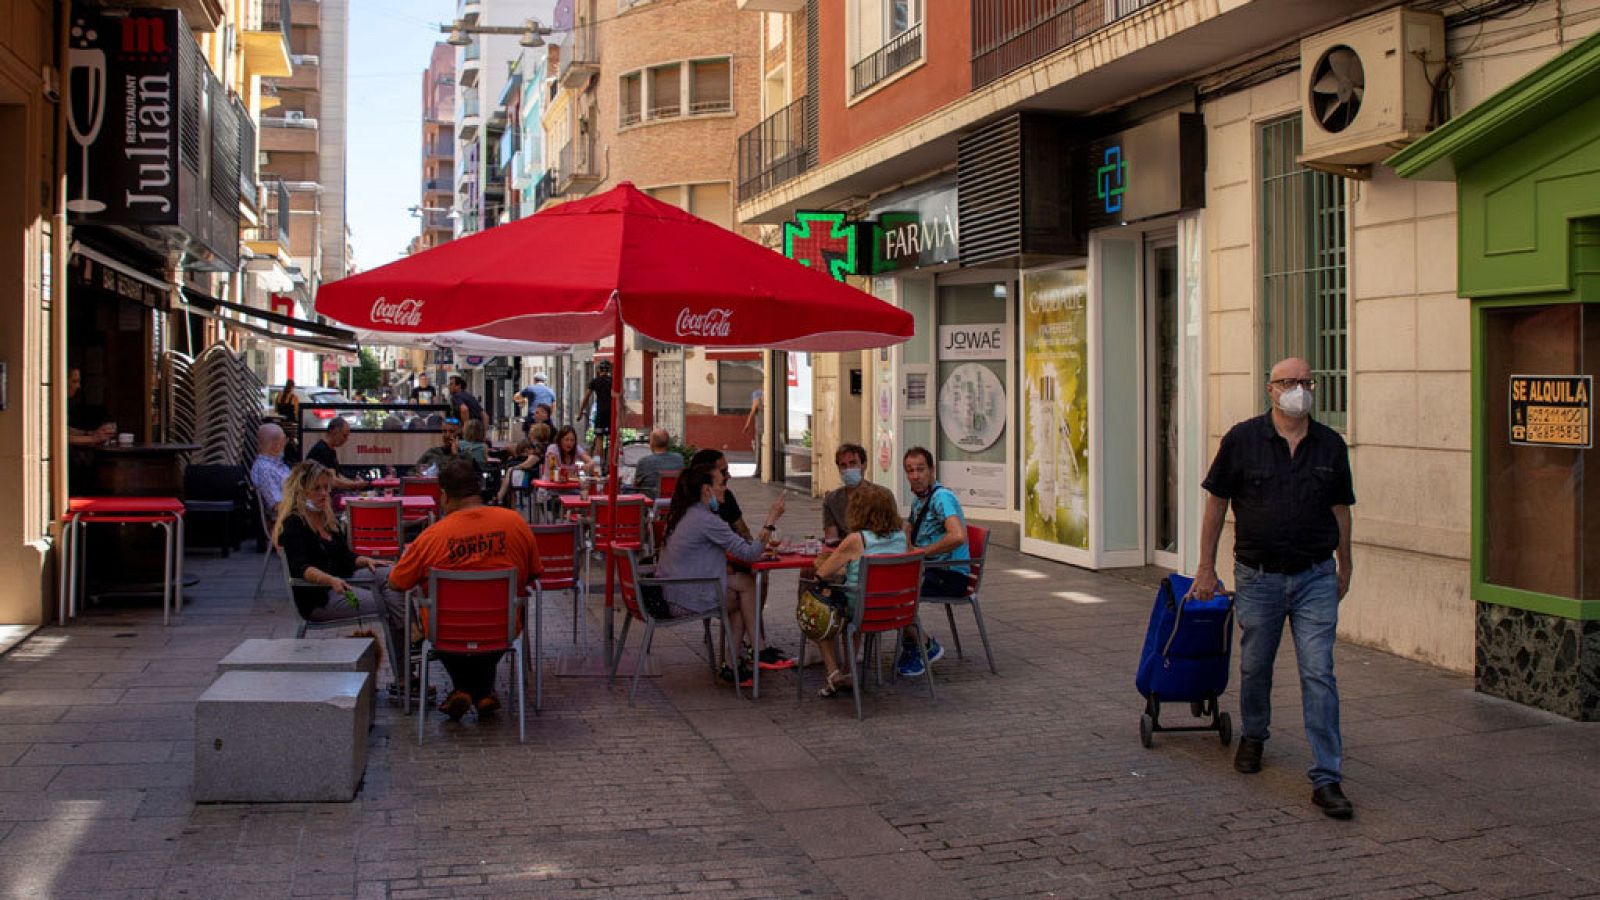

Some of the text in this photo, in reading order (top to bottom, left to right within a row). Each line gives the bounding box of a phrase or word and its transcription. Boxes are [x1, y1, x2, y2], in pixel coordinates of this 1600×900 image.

[125, 75, 137, 143] RESTAURANT
[886, 204, 959, 260] FARMÀ
[945, 328, 1001, 350] JOWAÉ
[1513, 380, 1587, 402] SE ALQUILA
